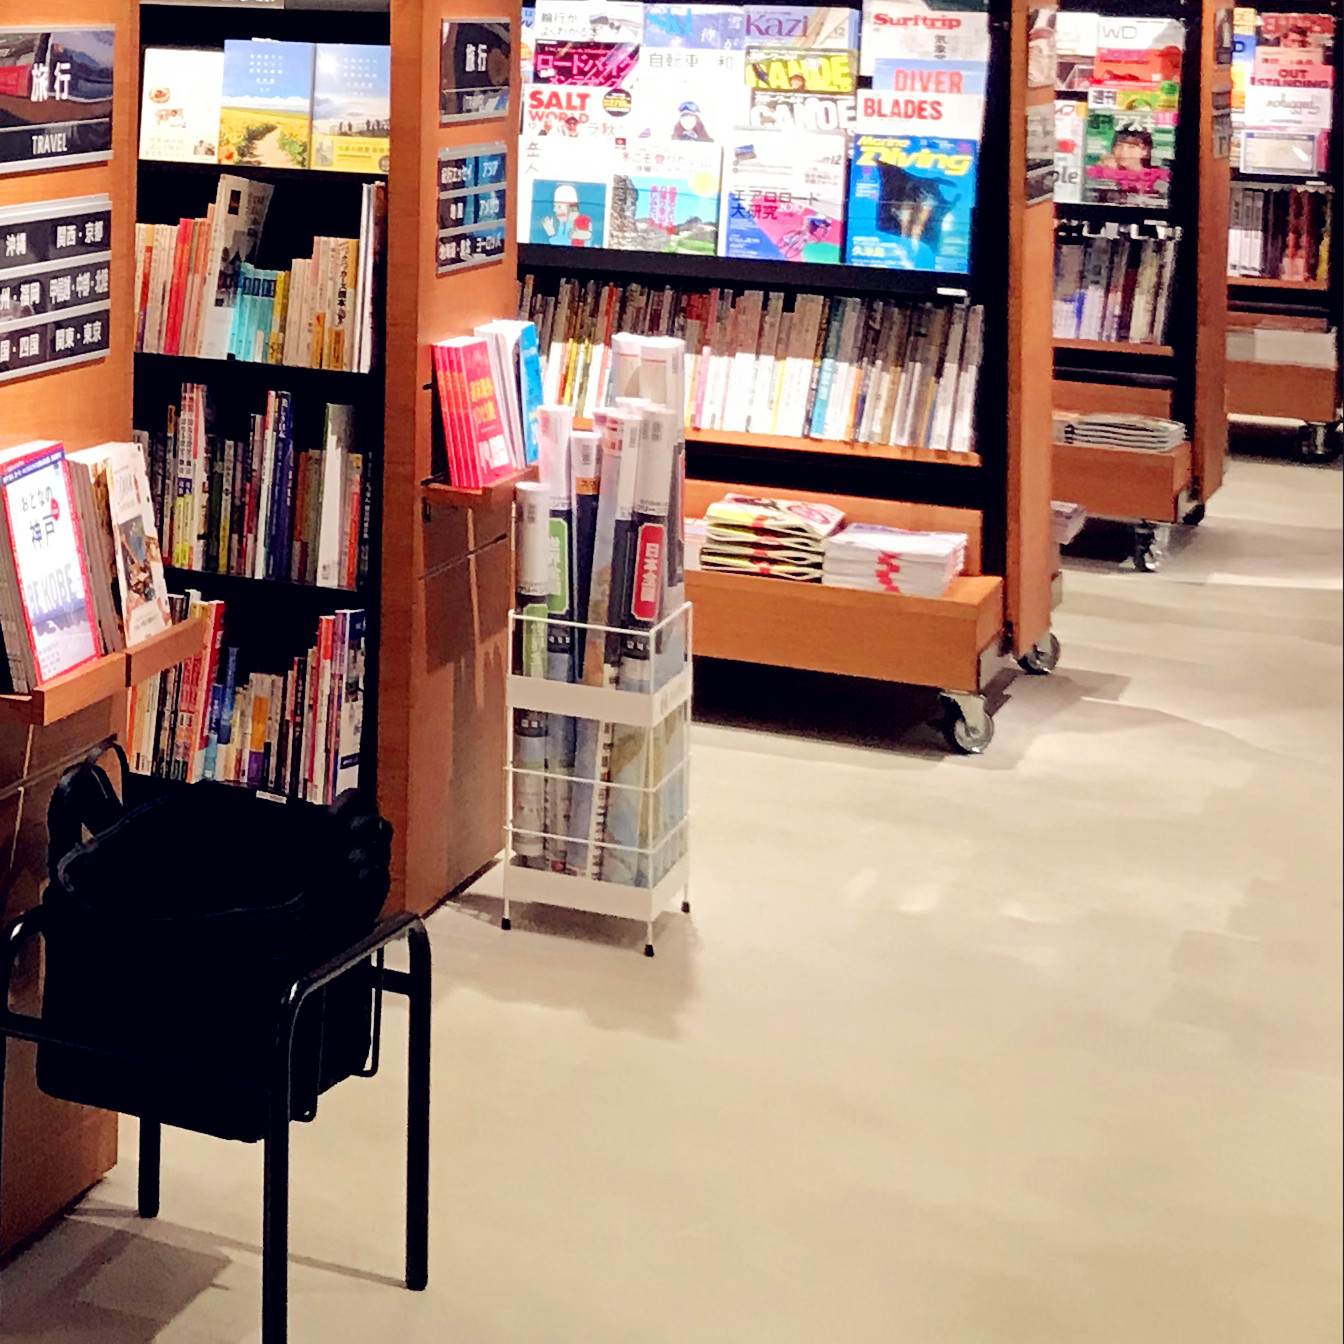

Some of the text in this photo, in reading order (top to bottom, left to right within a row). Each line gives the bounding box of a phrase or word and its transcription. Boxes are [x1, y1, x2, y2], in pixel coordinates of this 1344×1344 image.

[541, 12, 577, 23] 輪行が
[746, 14, 808, 37] Kazi
[873, 13, 961, 29] Surftrip
[1102, 26, 1138, 40] WD
[466, 43, 487, 73] 旅行
[536, 54, 640, 75] ロードバイク
[31, 61, 71, 102] 旅行
[894, 68, 964, 94] DIVER
[1278, 69, 1307, 79] OUT
[529, 90, 591, 111] SALT
[863, 98, 943, 120] BLADES
[31, 132, 68, 155] TRAVEL
[856, 136, 910, 147] Marine
[856, 145, 973, 176] Diving
[730, 204, 778, 220] 大研究
[6, 232, 27, 257] 沖縄
[56, 220, 104, 249] 関西・京都
[55, 321, 102, 352] 関東・東京
[21, 486, 53, 512] おとなの
[29, 515, 56, 551] 神戸
[42, 563, 73, 612] KOBE
